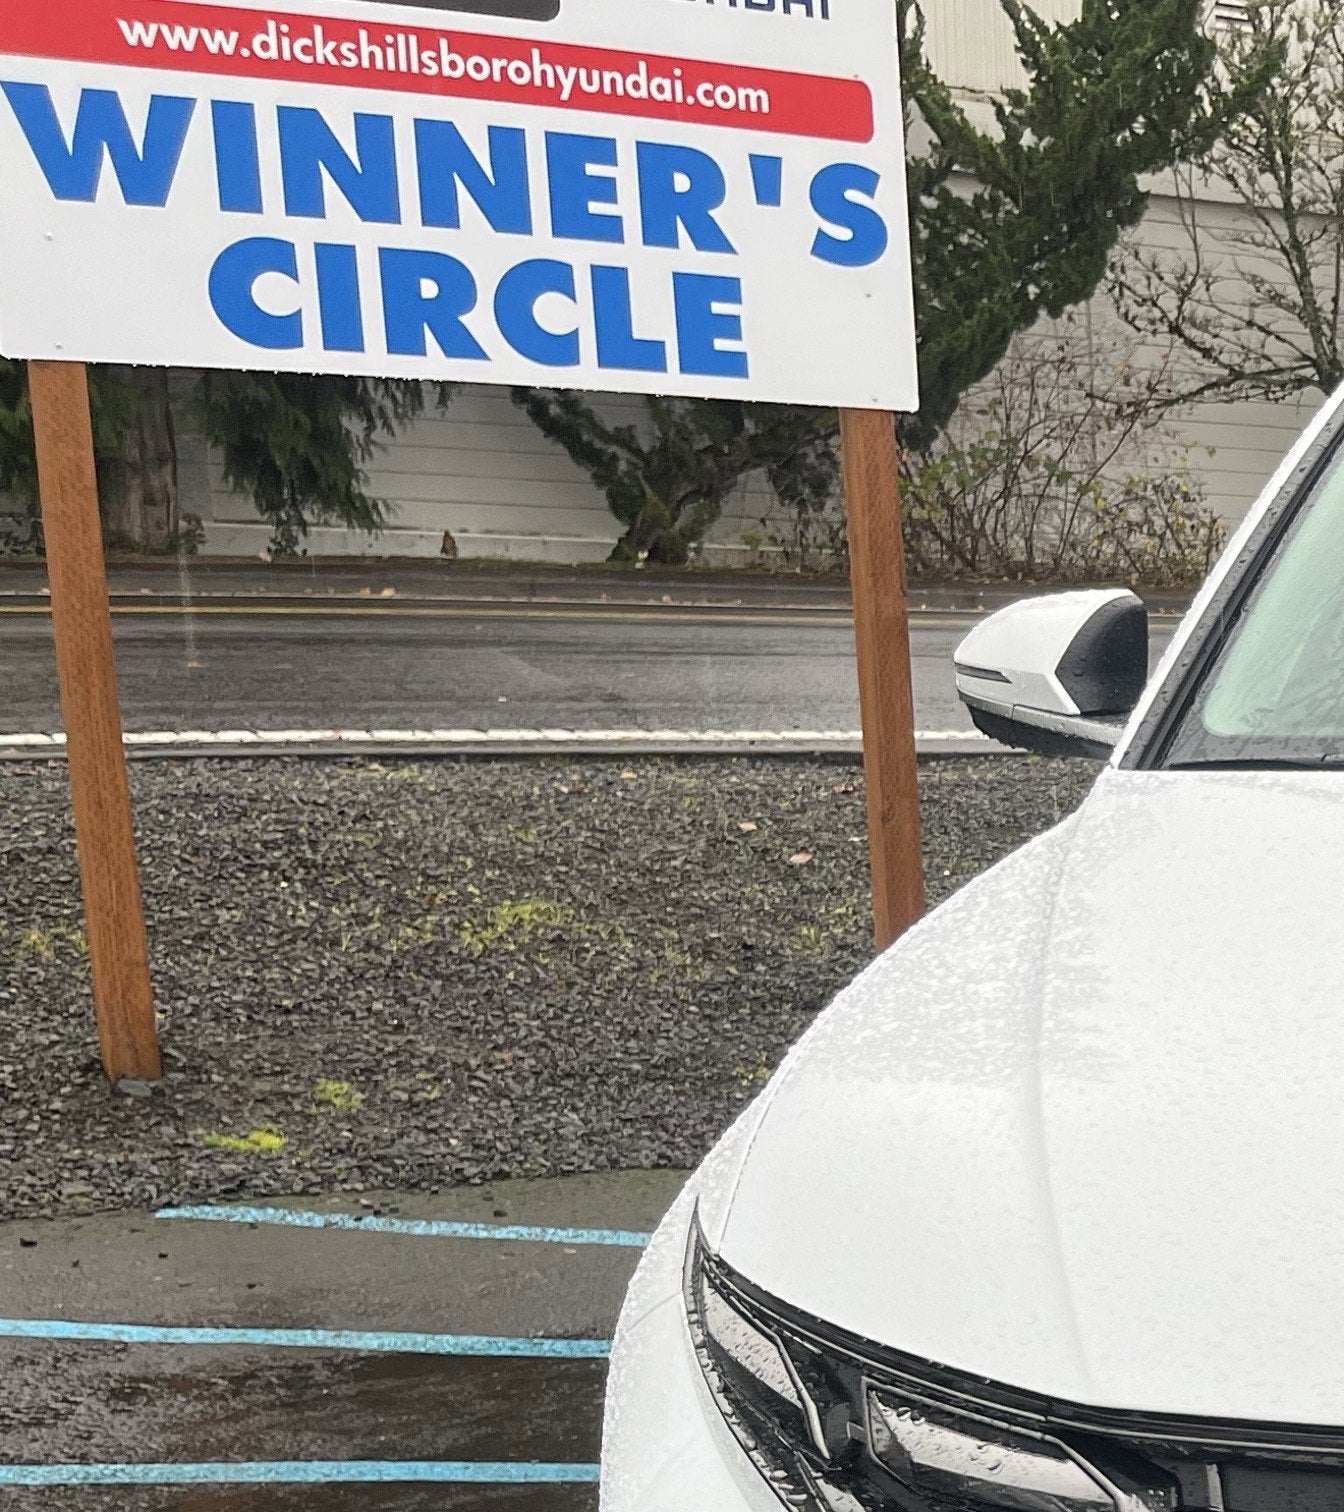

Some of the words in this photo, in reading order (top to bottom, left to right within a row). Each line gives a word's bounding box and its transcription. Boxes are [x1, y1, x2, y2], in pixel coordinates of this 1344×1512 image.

[116, 18, 770, 114] www.dickshillsborohyundai.com
[0, 80, 888, 267] WINNER'S
[207, 235, 749, 378] CIRCLE
